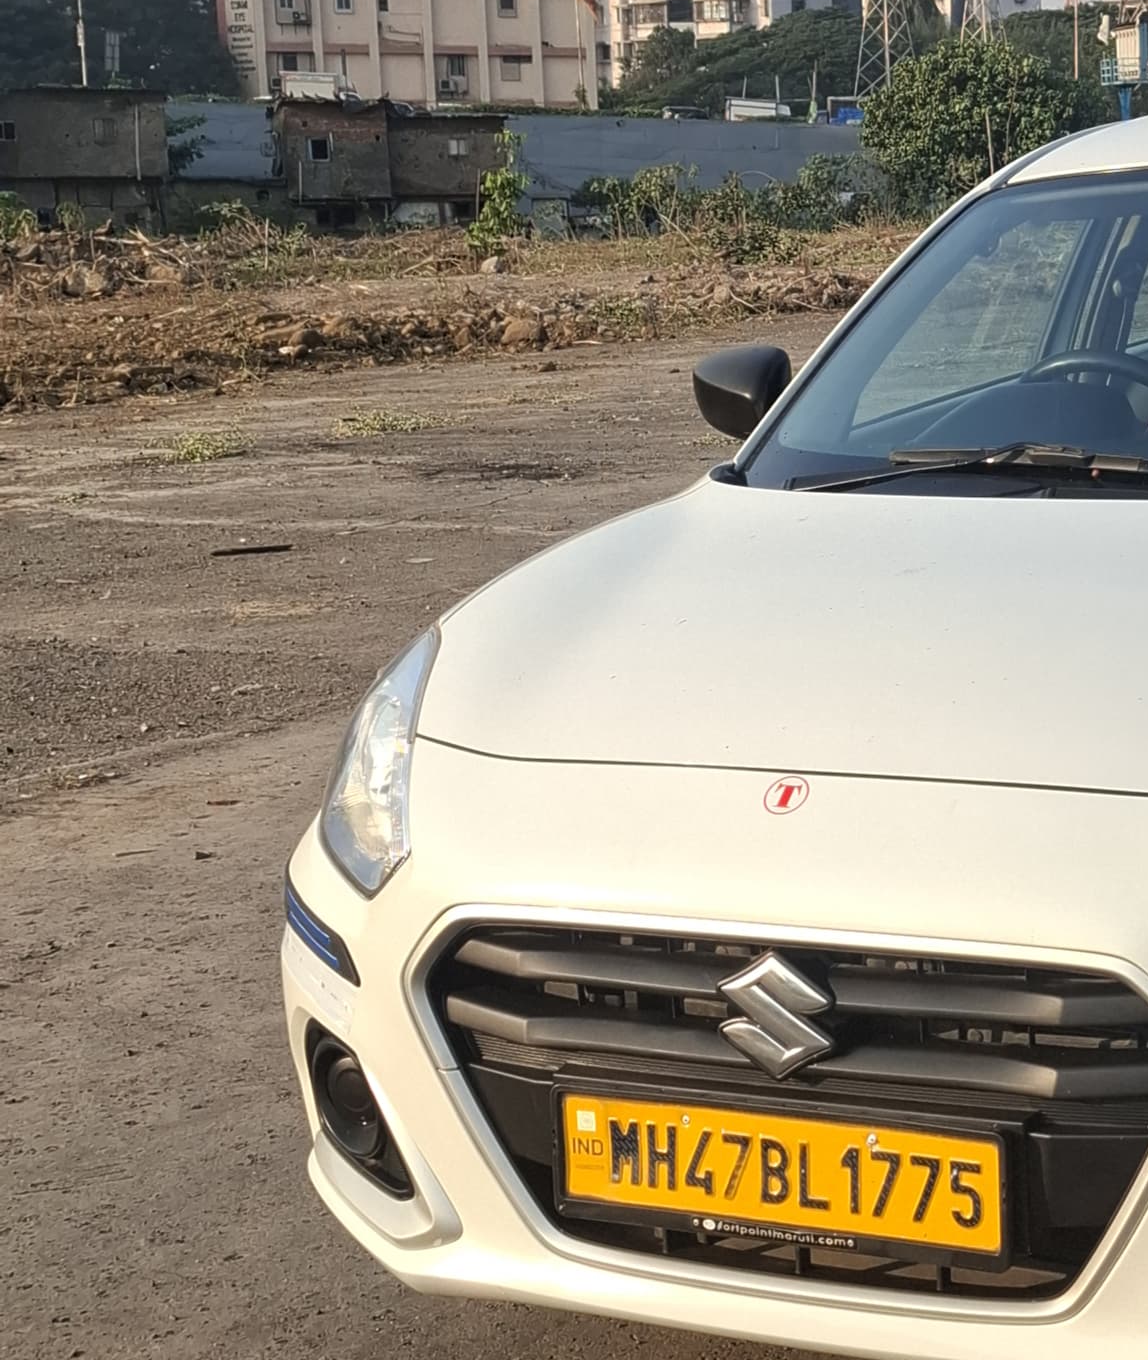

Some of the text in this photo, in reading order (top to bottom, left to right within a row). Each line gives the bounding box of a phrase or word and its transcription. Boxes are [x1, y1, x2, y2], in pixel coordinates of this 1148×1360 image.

[774, 783, 804, 808] T
[572, 1137, 604, 1156] IND
[608, 1119, 984, 1229] MH47BL1775
